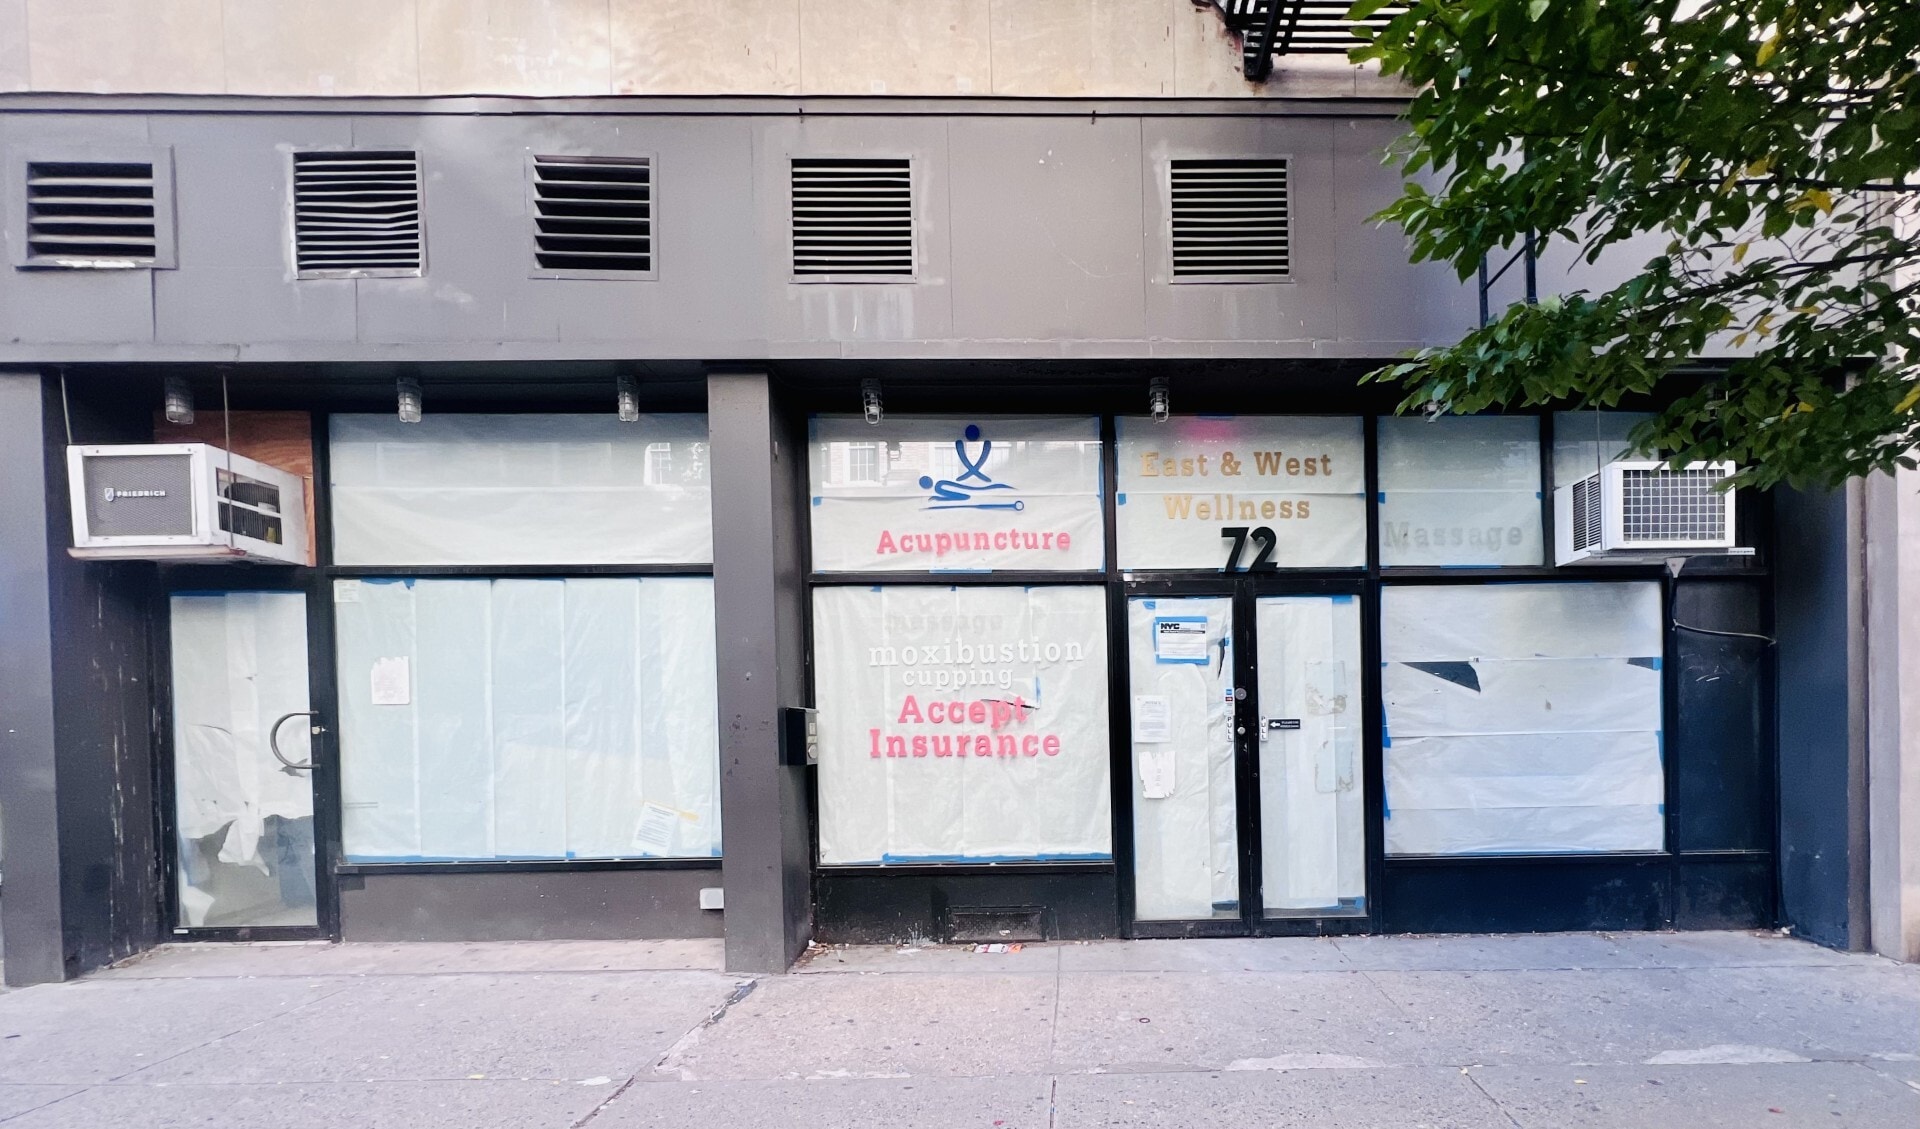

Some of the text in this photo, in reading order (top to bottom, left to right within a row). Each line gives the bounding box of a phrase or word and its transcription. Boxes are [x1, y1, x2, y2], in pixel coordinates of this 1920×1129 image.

[1140, 451, 1332, 477] East & West
[1163, 493, 1310, 520] Wellness
[876, 528, 1071, 556] Acupuncture
[1221, 526, 1278, 573] 72
[1383, 521, 1523, 552] Massage
[868, 636, 1084, 667] moxibustion
[902, 664, 1013, 691] cupping
[897, 695, 1029, 729] Accept
[869, 729, 1060, 758] Insurance
